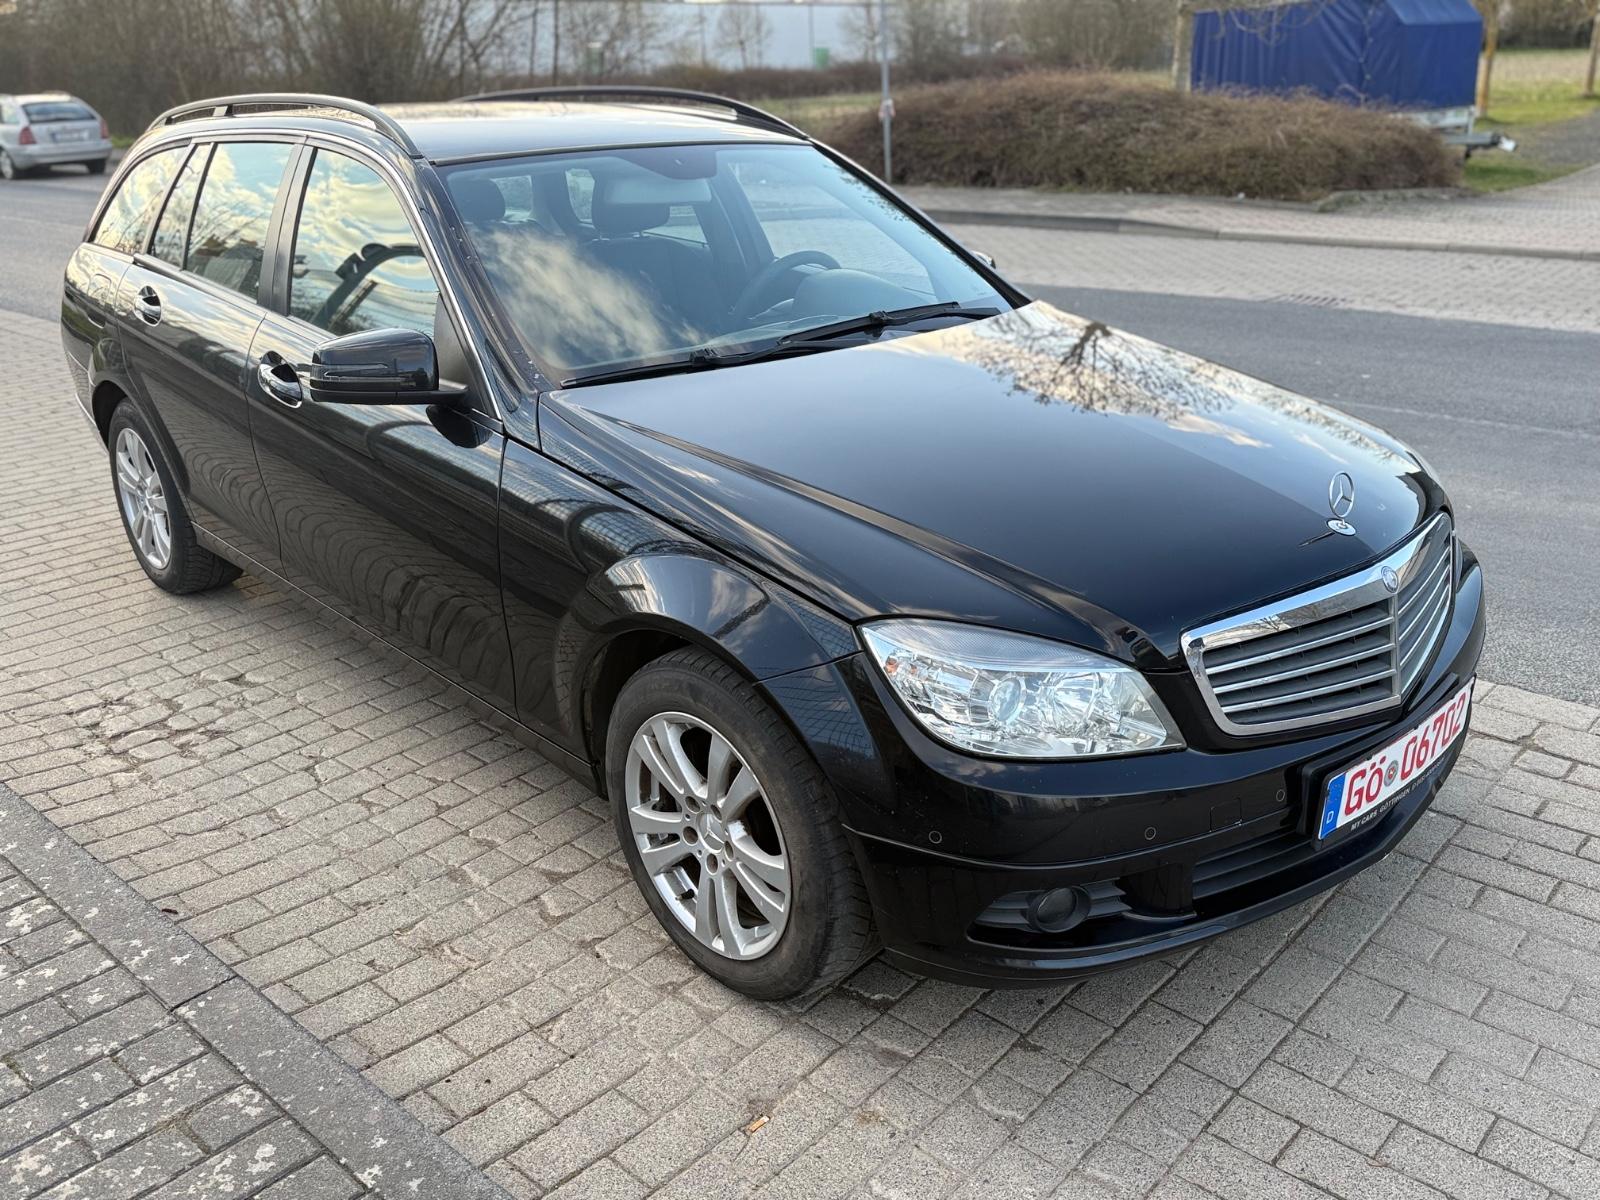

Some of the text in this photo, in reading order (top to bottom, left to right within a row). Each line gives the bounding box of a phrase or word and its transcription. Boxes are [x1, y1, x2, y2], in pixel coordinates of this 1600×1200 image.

[1344, 756, 1387, 816] GÖ
[1400, 692, 1466, 781] 06702
[1326, 811, 1334, 824] D
[1350, 819, 1361, 831] MY
[1361, 809, 1378, 825] CARS
